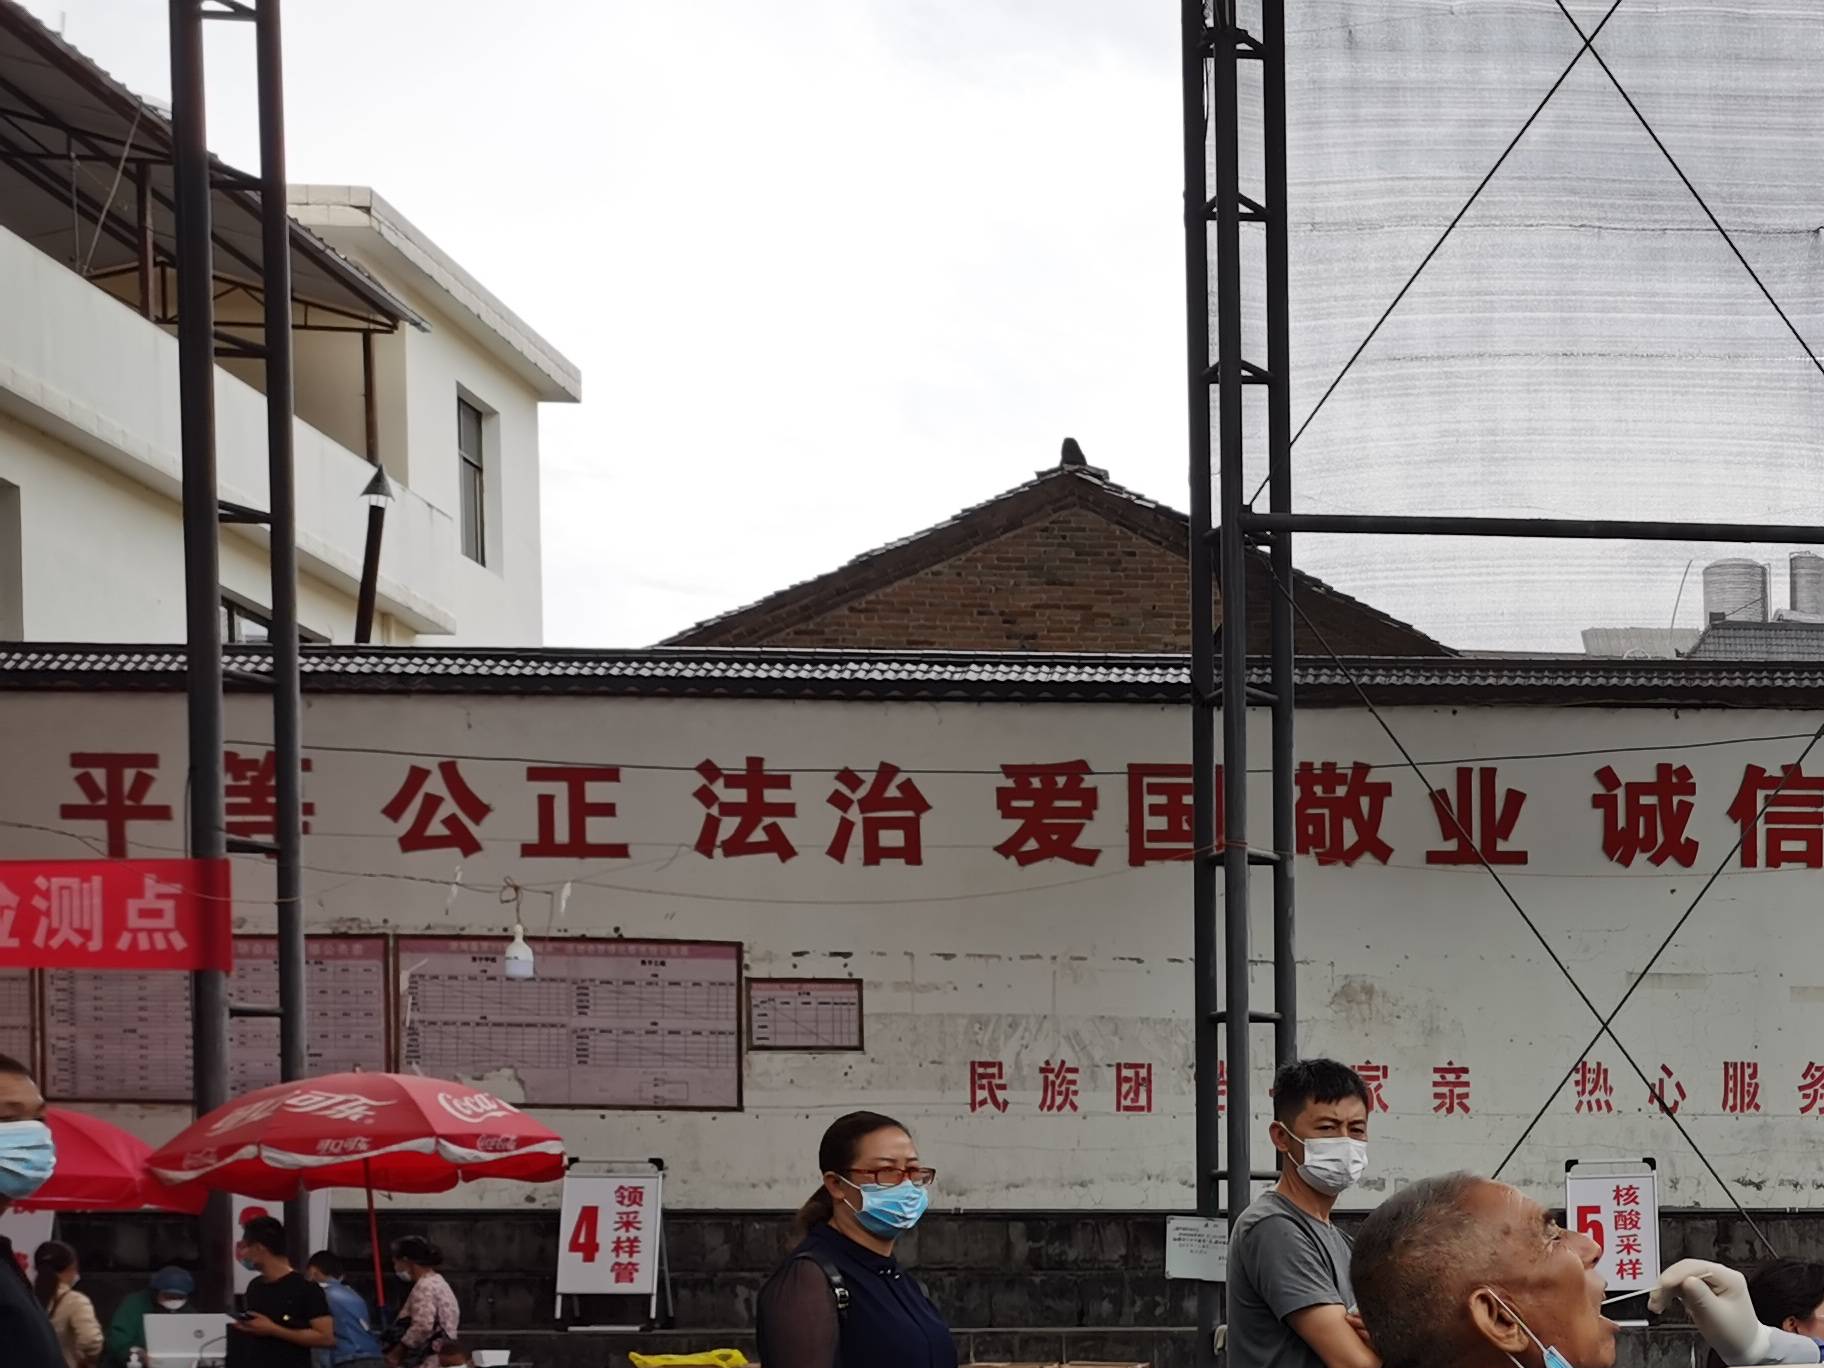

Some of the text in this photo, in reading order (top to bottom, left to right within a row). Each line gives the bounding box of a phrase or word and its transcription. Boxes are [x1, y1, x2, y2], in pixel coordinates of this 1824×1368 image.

[382, 759, 630, 859] 公正
[694, 757, 930, 866] 法治
[995, 760, 1226, 866] 爱国
[1294, 762, 1527, 867] 敬业
[969, 1060, 1472, 1114] 民族团家亲
[567, 1204, 601, 1264] 4
[609, 1184, 646, 1285] 领采样管
[1575, 1204, 1606, 1260] 5
[1612, 1184, 1644, 1281] 核酸采样
